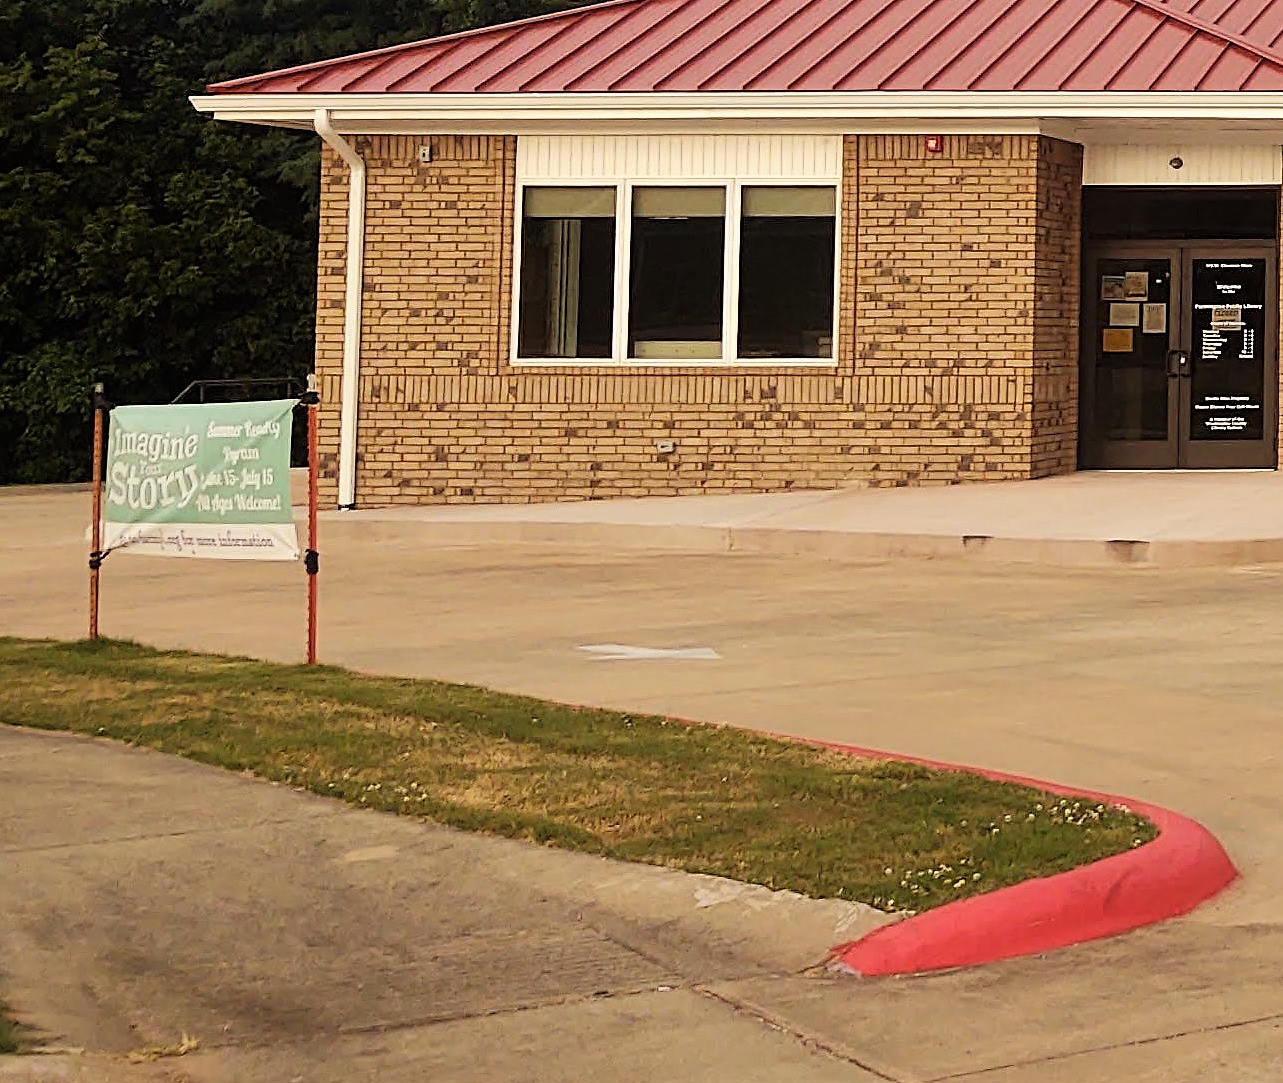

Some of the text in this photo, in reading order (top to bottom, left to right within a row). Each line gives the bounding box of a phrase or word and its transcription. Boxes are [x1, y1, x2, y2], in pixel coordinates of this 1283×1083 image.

[113, 428, 199, 463] Imagine
[108, 461, 199, 510] Story
[234, 493, 282, 512] Welcome!
